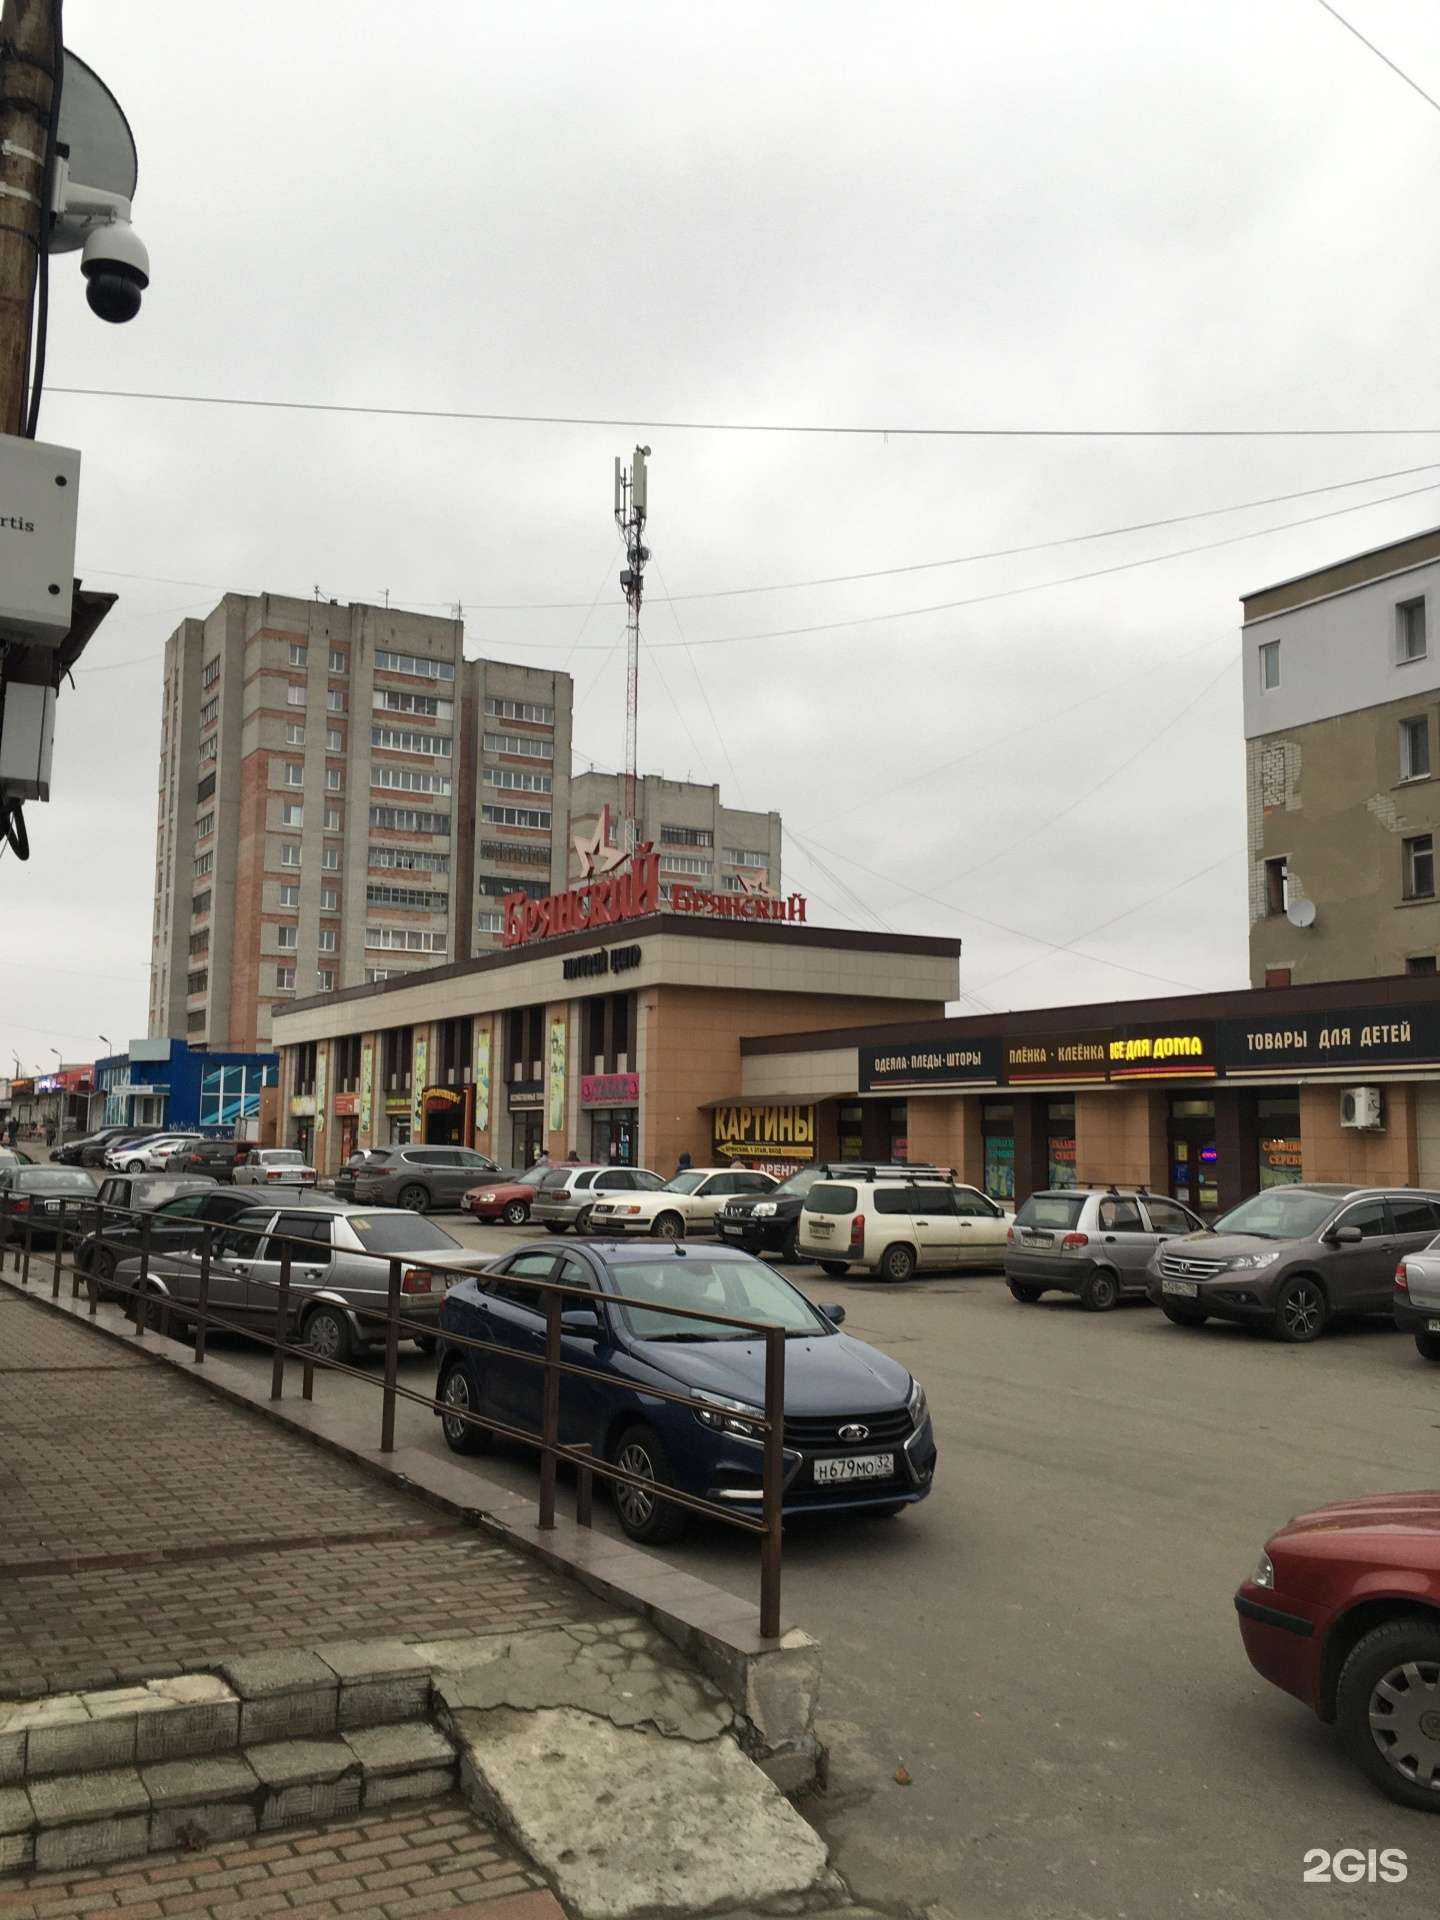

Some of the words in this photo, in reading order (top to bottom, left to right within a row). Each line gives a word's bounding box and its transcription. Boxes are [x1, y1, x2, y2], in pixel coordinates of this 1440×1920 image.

[1126, 1039, 1151, 1060] ДЛЯ
[1153, 1036, 1202, 1059] ДОМА
[1246, 1030, 1308, 1051] ТОВАРЫ
[1318, 1027, 1351, 1049] ДЛЯ
[1360, 1020, 1411, 1047] ДЕТЕЙ
[715, 1105, 814, 1142] КАРТИНЫ
